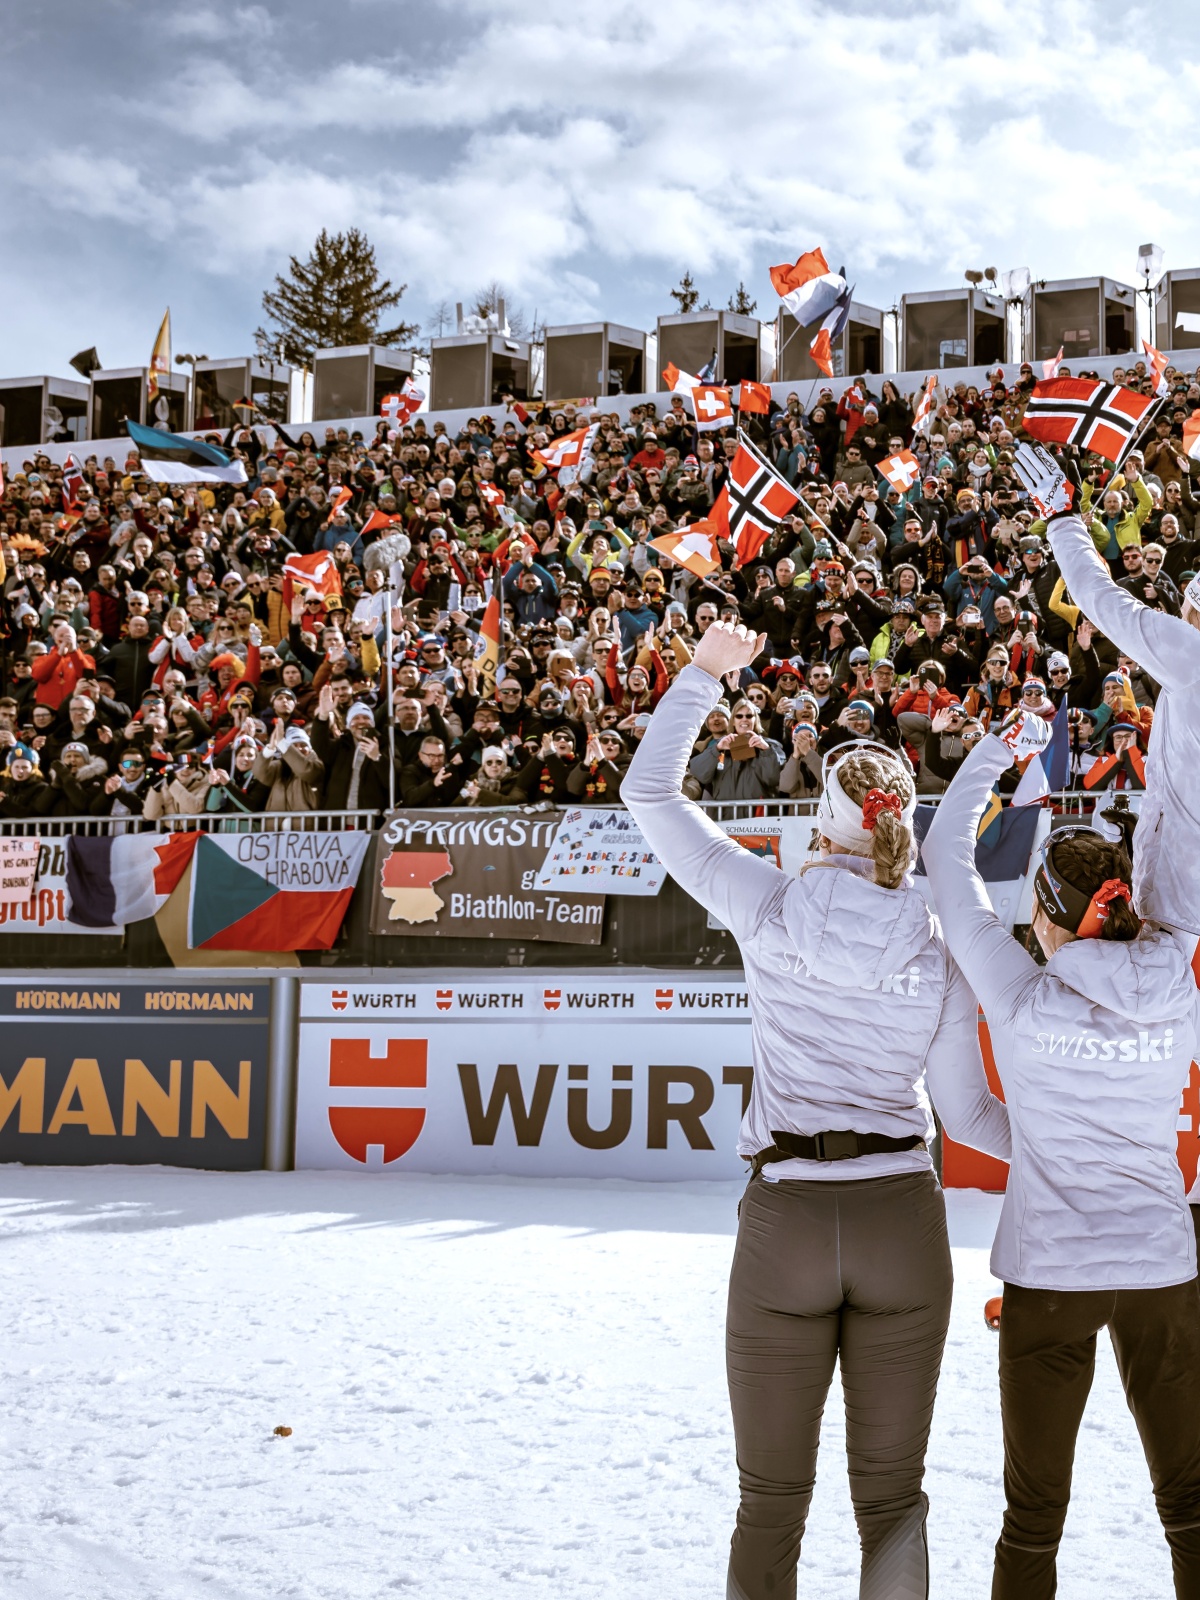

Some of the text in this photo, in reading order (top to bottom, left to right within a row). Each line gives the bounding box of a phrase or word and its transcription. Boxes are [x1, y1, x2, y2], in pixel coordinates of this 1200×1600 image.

[1044, 474, 1064, 505] Roeckl
[726, 826, 783, 834] SCHMALKALDEN
[238, 833, 344, 862] OSTRAVA
[265, 855, 352, 886] HRABOVÁ
[450, 893, 603, 925] Biathlon-Team
[15, 989, 254, 1011] HÖRMANN HÖRMANN
[353, 992, 417, 1009] WÜRTH
[457, 992, 524, 1009] WÜRTH
[566, 993, 635, 1009] WÜRTH
[1031, 1028, 1174, 1063] swissski
